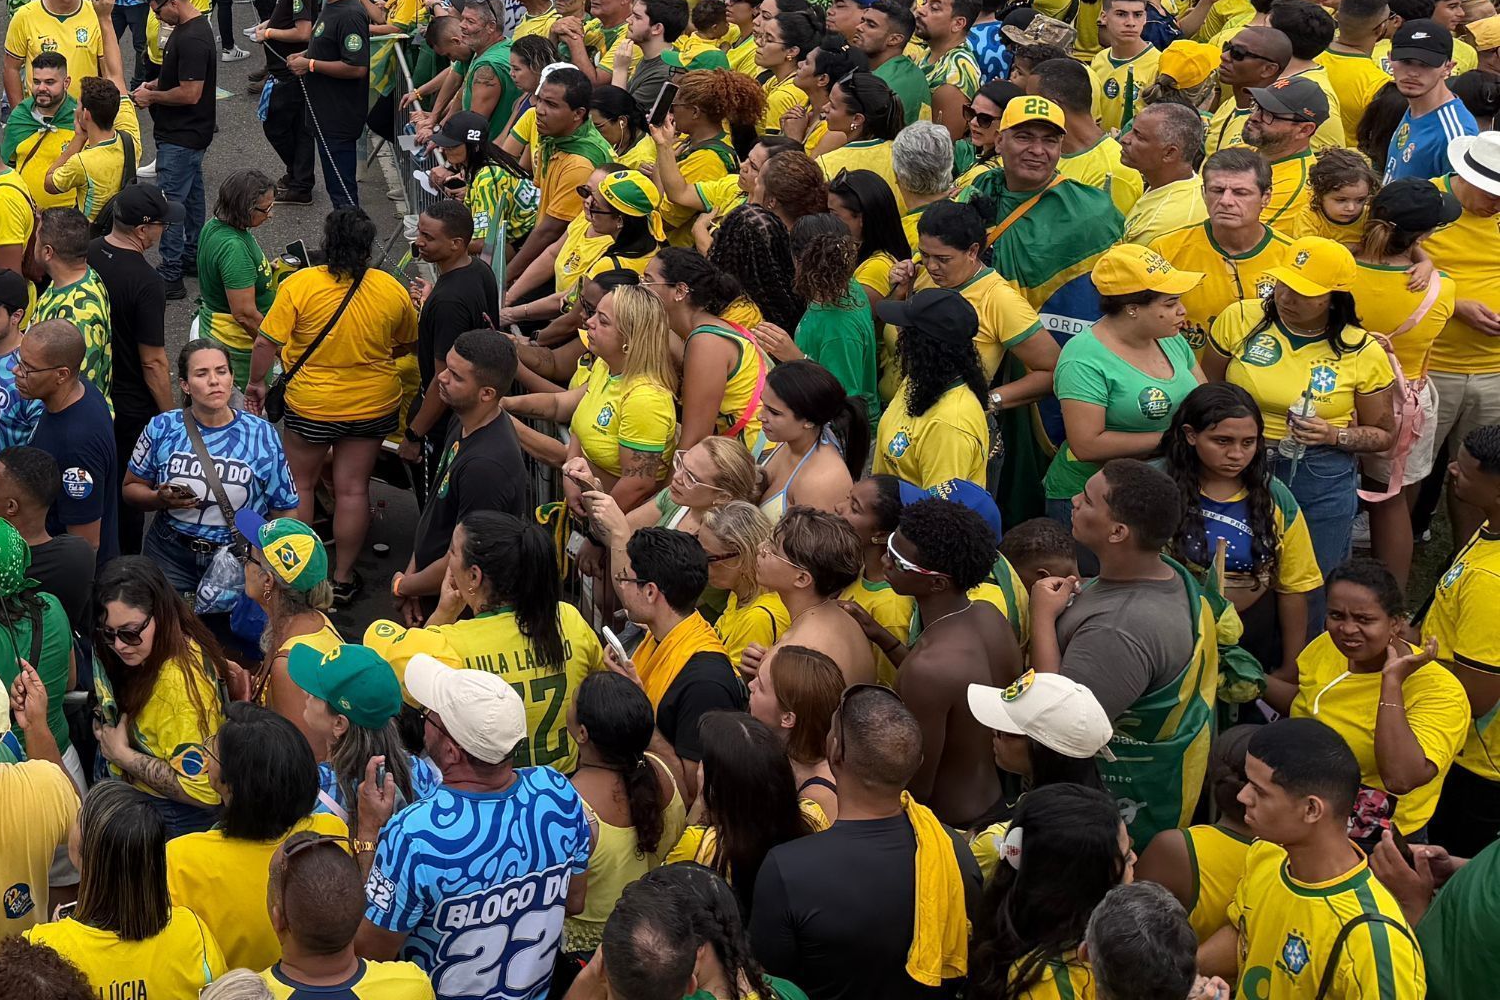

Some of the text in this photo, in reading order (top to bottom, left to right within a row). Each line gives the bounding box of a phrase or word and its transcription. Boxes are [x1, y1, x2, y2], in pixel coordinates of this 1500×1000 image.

[1024, 98, 1049, 117] 22
[467, 129, 481, 141] 22
[1049, 317, 1084, 334] ORD
[1256, 335, 1276, 350] 22
[63, 473, 77, 482] 22
[170, 458, 252, 483] BLOO DO
[465, 653, 509, 674] LULA
[365, 874, 392, 910] 22
[444, 873, 570, 929] BLOCO DO
[438, 904, 566, 997] 22
